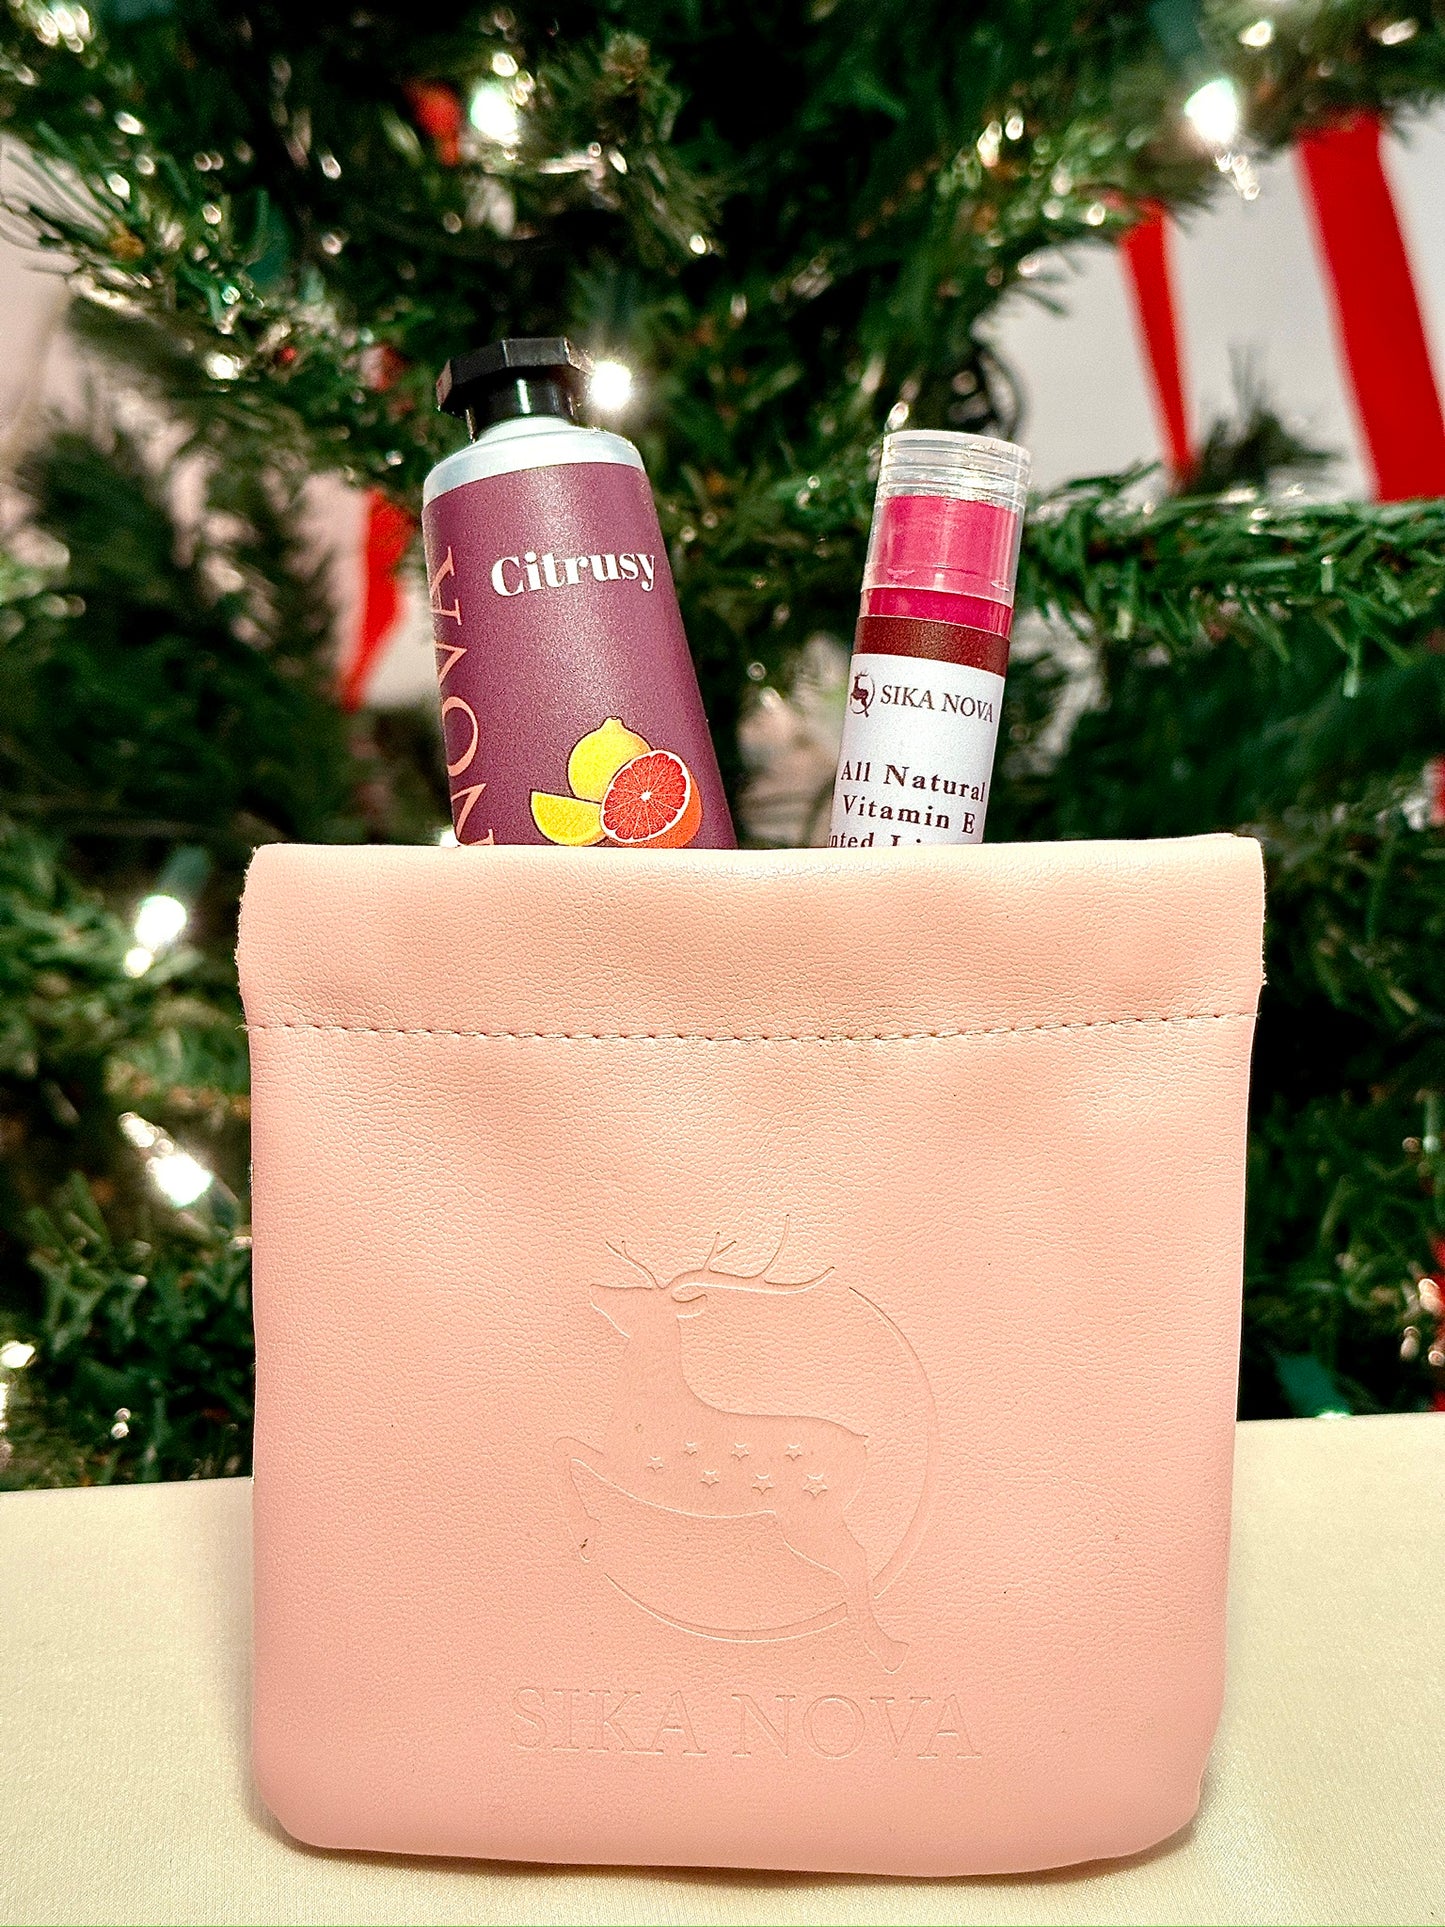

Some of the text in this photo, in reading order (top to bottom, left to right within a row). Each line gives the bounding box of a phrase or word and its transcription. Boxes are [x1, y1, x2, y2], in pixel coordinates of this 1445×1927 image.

[490, 550, 656, 597] Citrusy
[880, 684, 993, 723] SIKA NOVA
[840, 760, 986, 803] All Natural
[843, 794, 976, 835] Vitamin E
[829, 832, 875, 848] nted
[509, 1686, 982, 1760] SIKA NOVA
